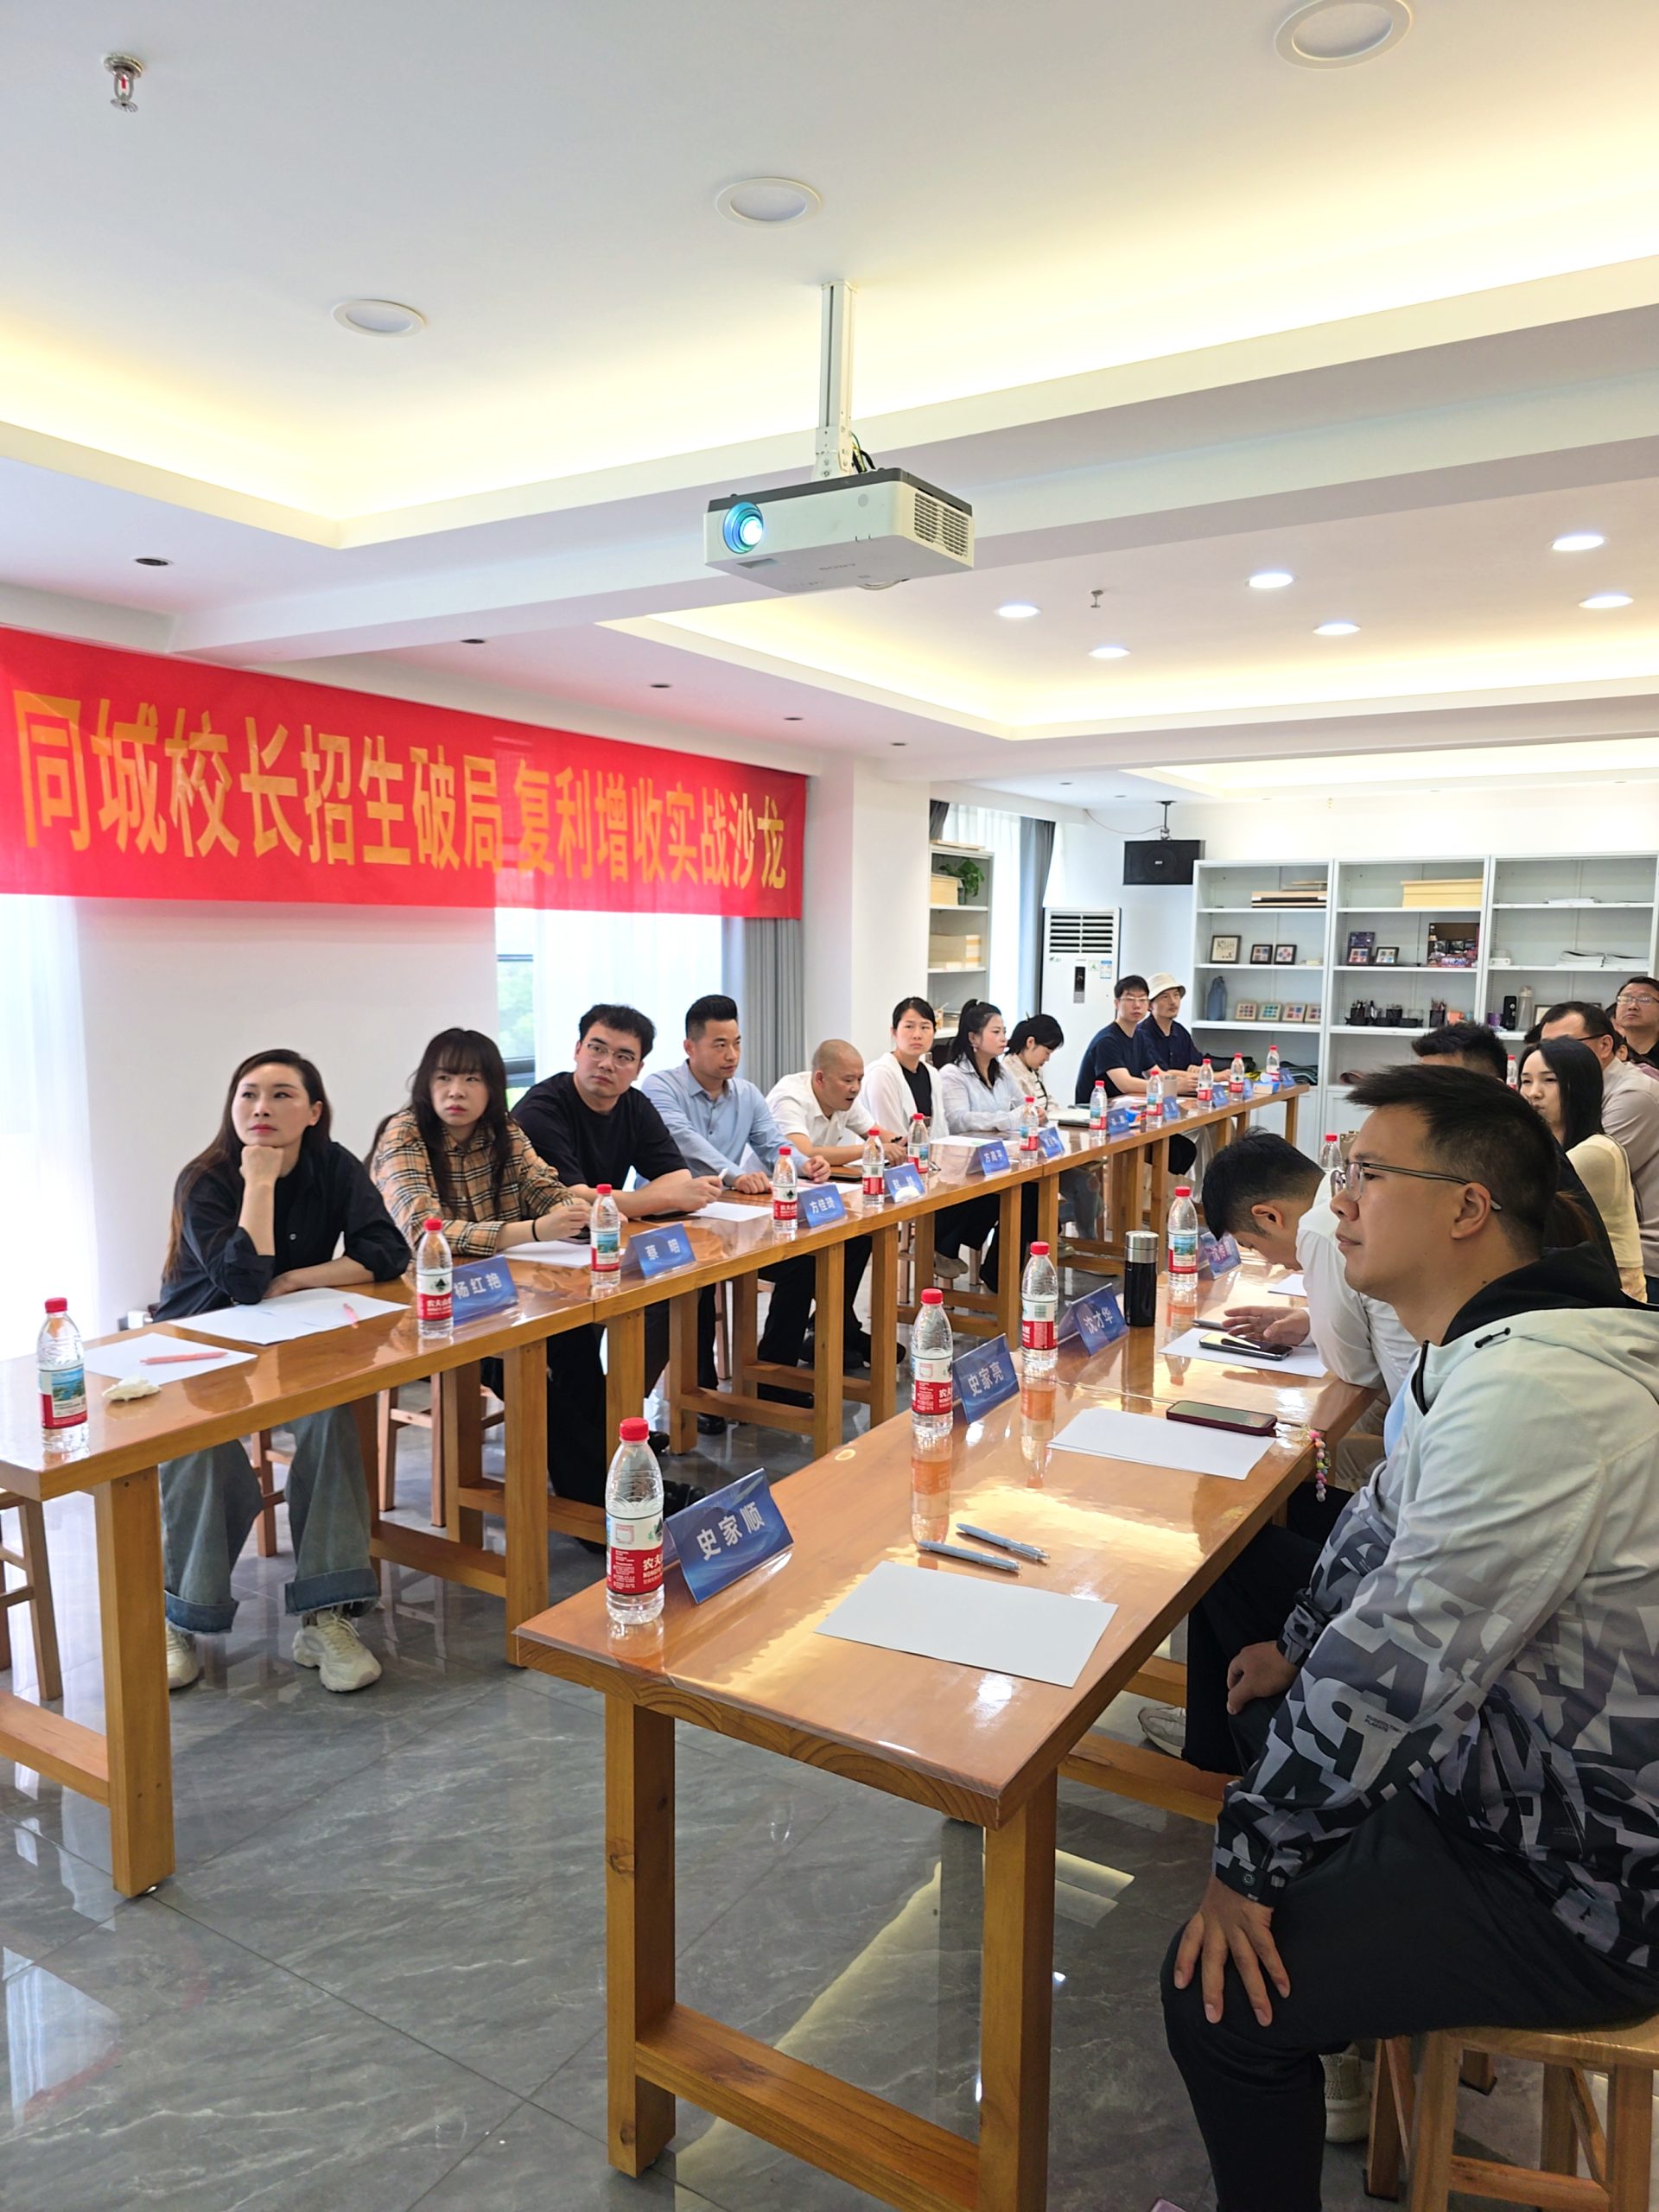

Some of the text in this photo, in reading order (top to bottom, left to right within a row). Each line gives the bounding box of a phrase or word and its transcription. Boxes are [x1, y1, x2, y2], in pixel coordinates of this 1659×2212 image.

[14, 690, 786, 889] 同城校长招生破局复利增收实战沙龙
[1083, 1306, 1113, 1335] 沈才华
[968, 1361, 1004, 1397] 史家亮
[696, 1501, 766, 1561] 史家顺
